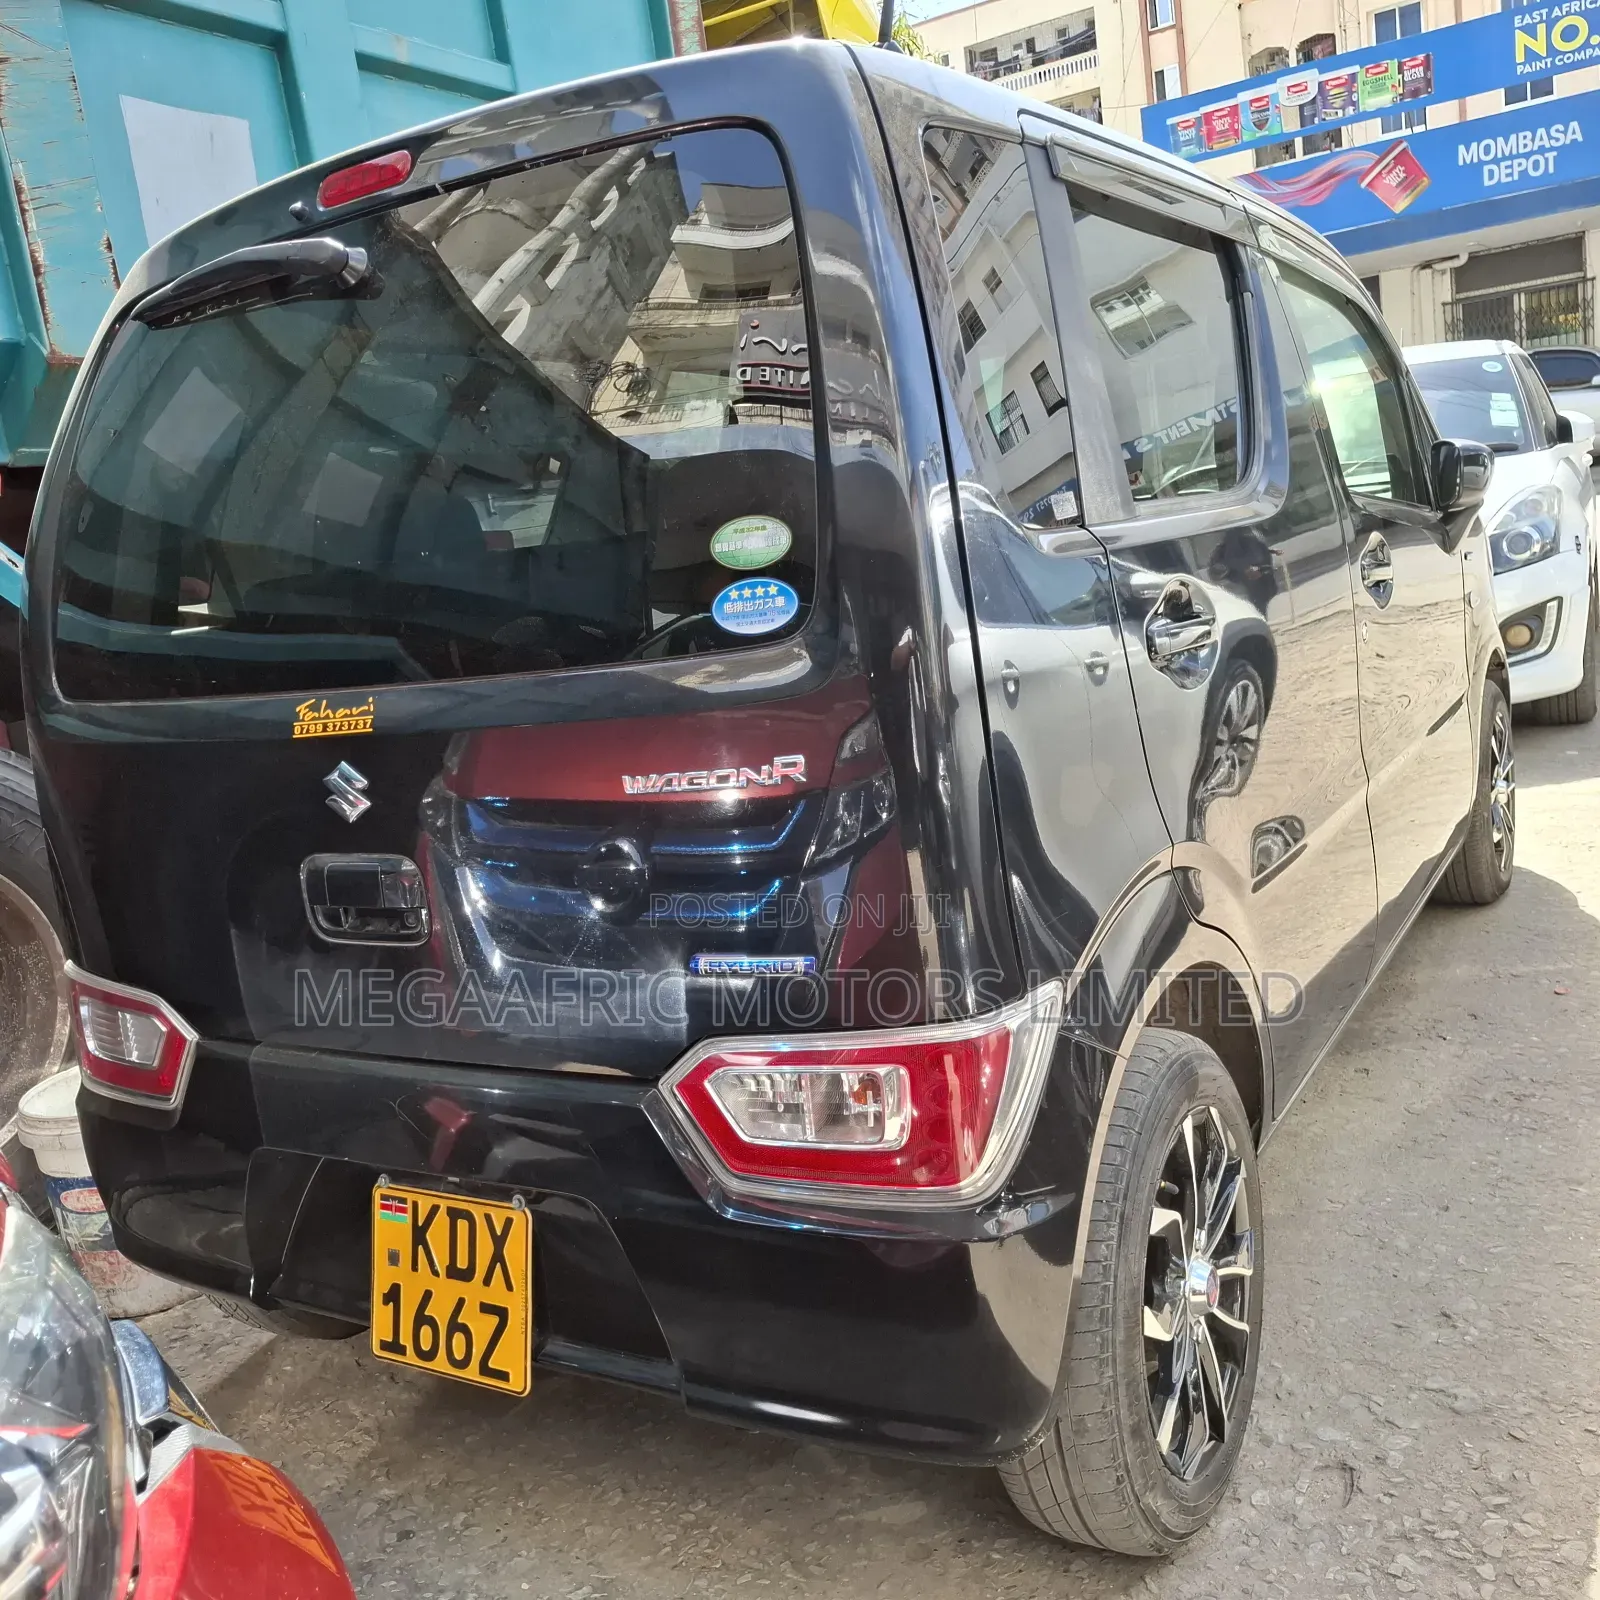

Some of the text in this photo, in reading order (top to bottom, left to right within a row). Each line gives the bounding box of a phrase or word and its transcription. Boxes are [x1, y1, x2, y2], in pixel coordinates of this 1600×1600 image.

[1514, 8, 1548, 28] EAST
[1514, 15, 1600, 63] NO.
[1362, 74, 1393, 86] EGGSHELL
[1516, 58, 1552, 75] PAINT
[1458, 120, 1583, 166] MOMBASA
[1483, 151, 1557, 187] DEPOT
[723, 596, 785, 614] 低排出ガス車
[294, 719, 372, 734] 0799 373737
[411, 1200, 514, 1292] KDX
[379, 1282, 511, 1383] 166Z
